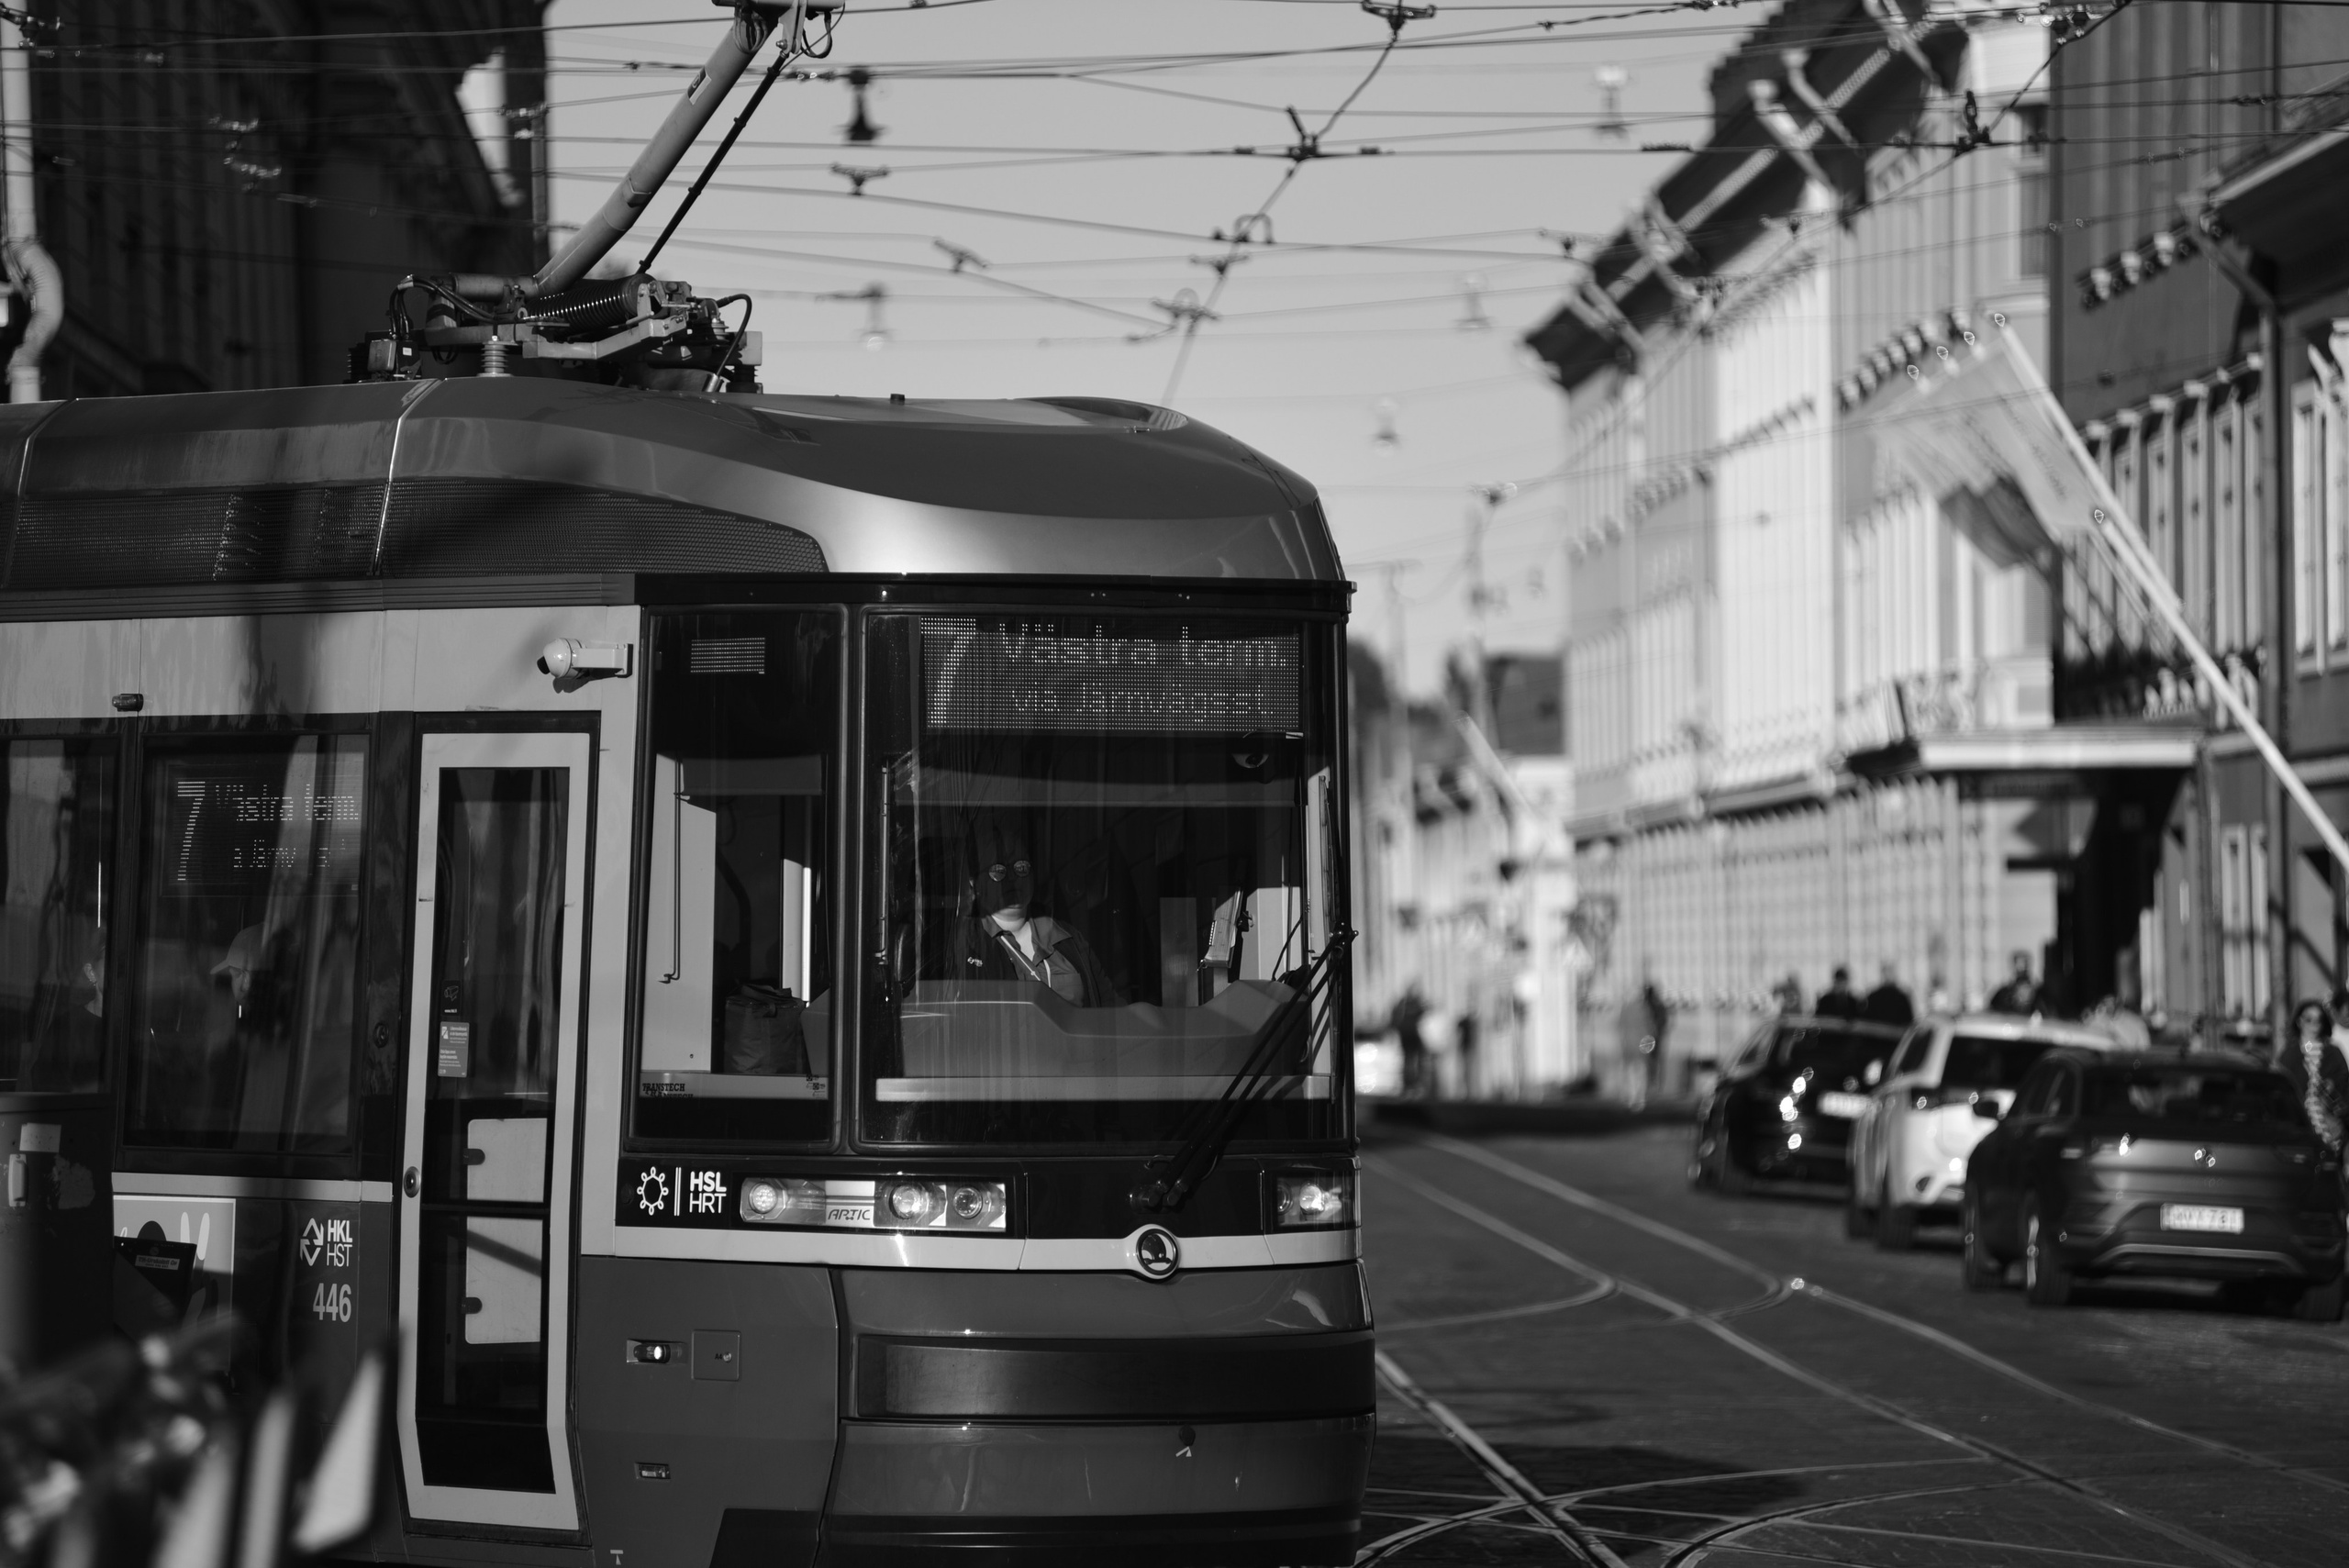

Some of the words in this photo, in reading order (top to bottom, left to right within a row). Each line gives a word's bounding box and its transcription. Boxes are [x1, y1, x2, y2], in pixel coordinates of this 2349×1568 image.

[920, 617, 976, 724] 7
[998, 623, 1156, 666] Västra
[1011, 681, 1061, 712] via
[177, 781, 206, 881] 7
[641, 1083, 686, 1092] TRANSTECH
[690, 1171, 727, 1192] HSL
[689, 1193, 727, 1214] HRT
[828, 1208, 871, 1220] ARTIC
[328, 1218, 353, 1242] HKL
[327, 1243, 353, 1267] HST
[313, 1283, 351, 1322] 446
